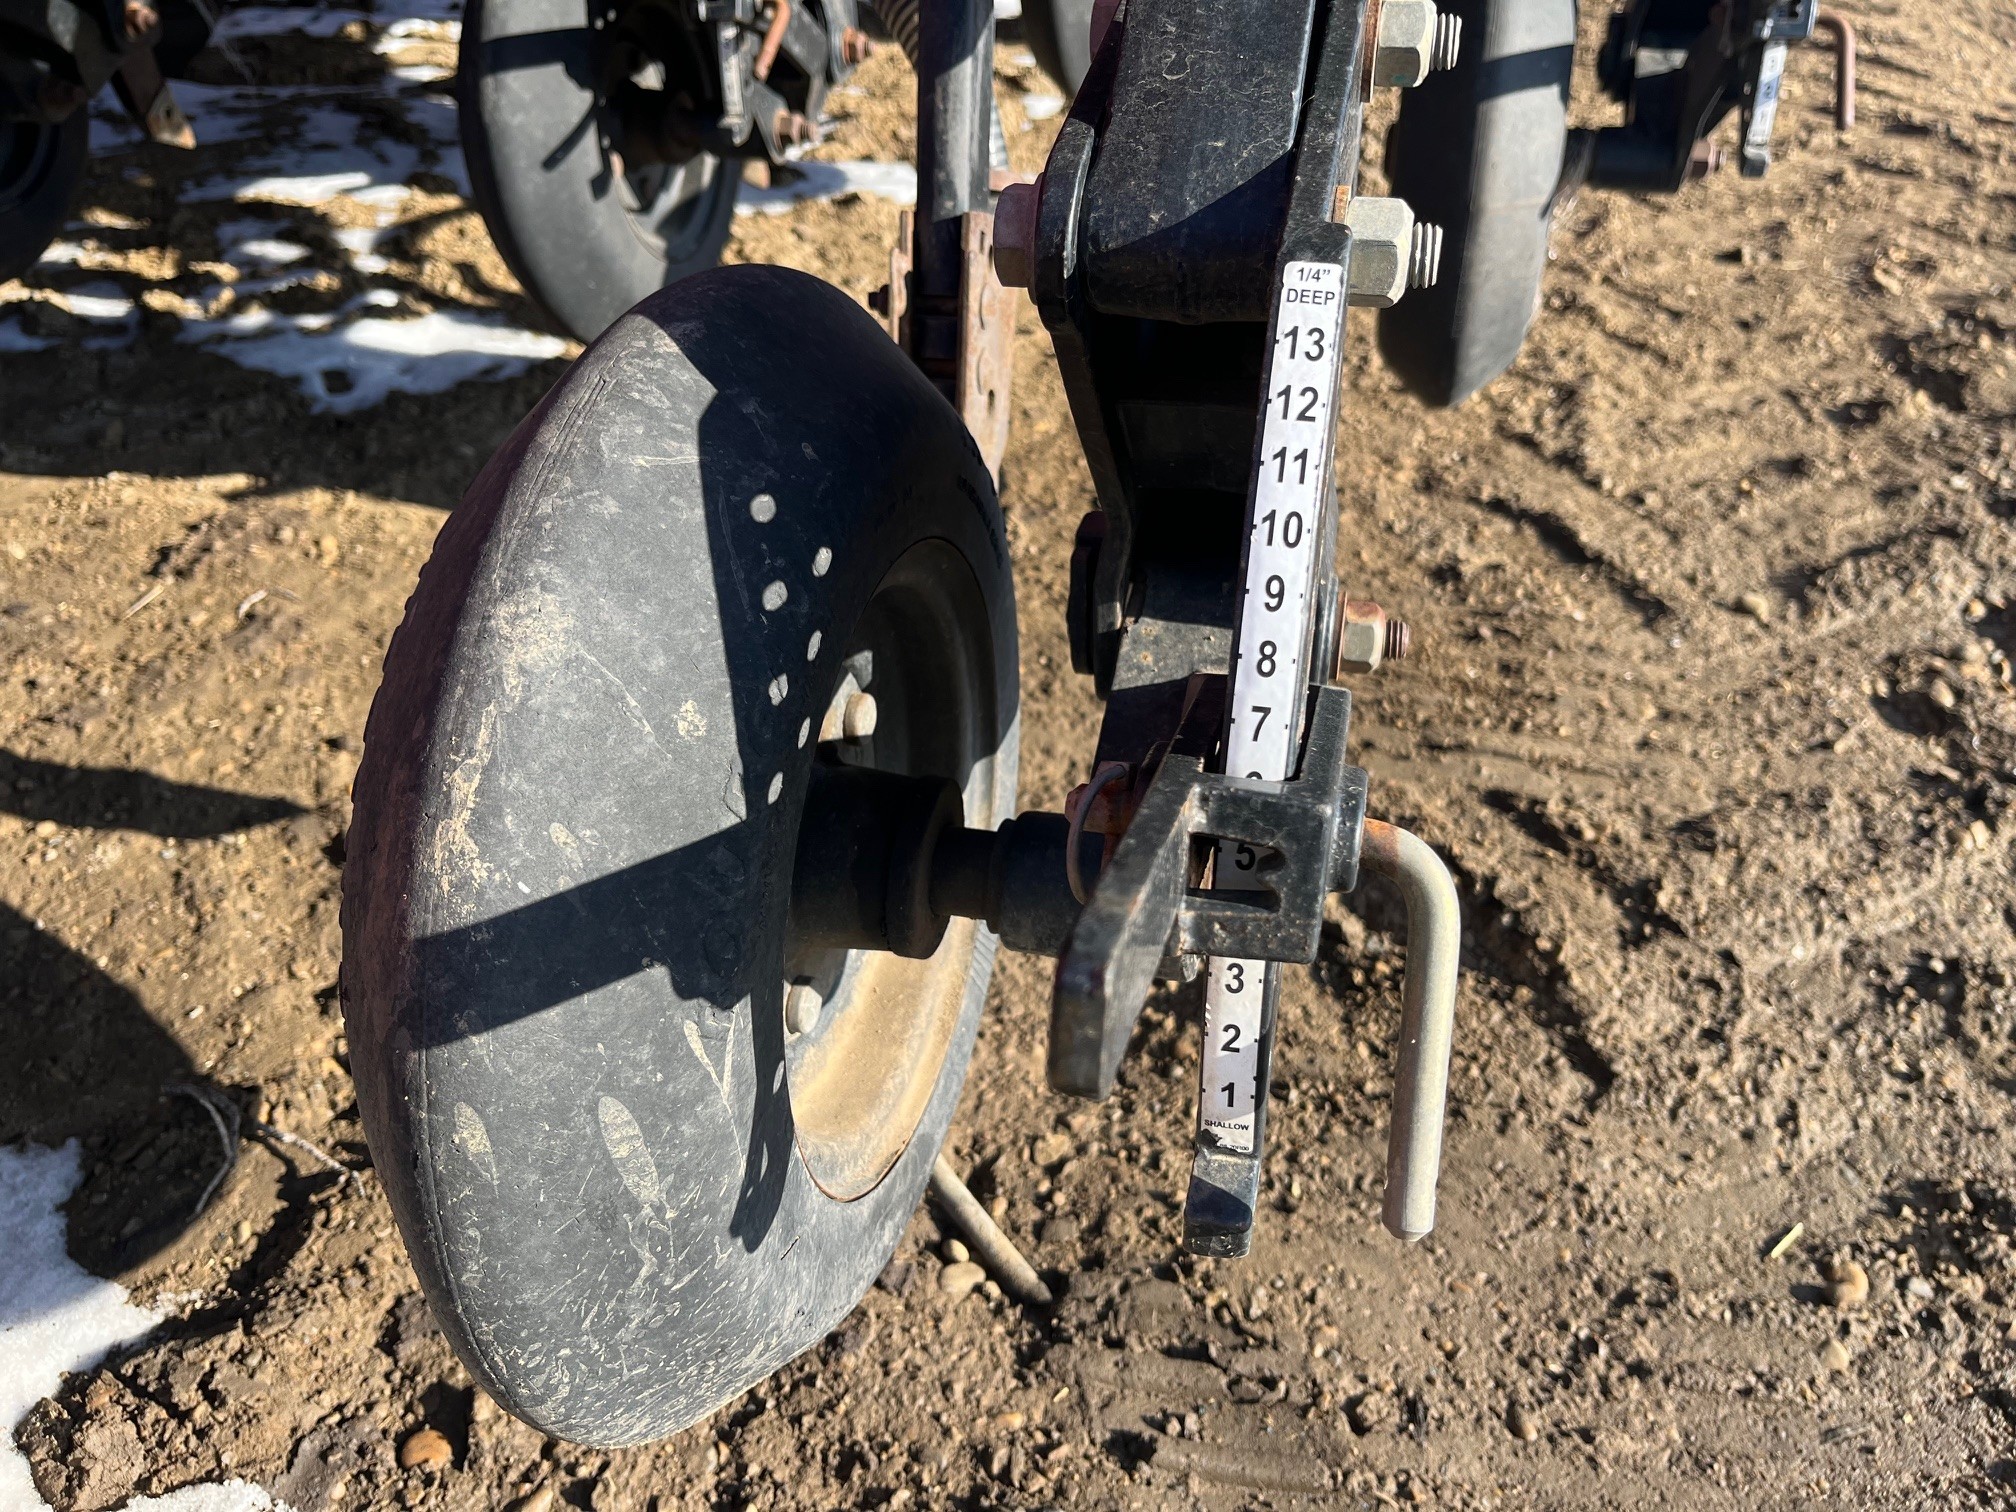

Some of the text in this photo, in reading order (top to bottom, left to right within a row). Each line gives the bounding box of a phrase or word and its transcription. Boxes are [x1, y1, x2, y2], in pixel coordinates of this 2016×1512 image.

[1286, 288, 1336, 306] DEEP
[1284, 325, 1325, 362] 13
[1276, 384, 1319, 422] 12
[1272, 446, 1309, 485] 11
[1261, 509, 1303, 549] 10
[1264, 574, 1285, 612] 9
[1256, 640, 1277, 678] 8
[1251, 706, 1272, 742] 7
[1235, 843, 1256, 871] 5
[1225, 962, 1244, 994] 3
[1221, 1023, 1242, 1053] 2
[1221, 1082, 1235, 1108] 1
[1204, 1118, 1250, 1131] SHALLOW
